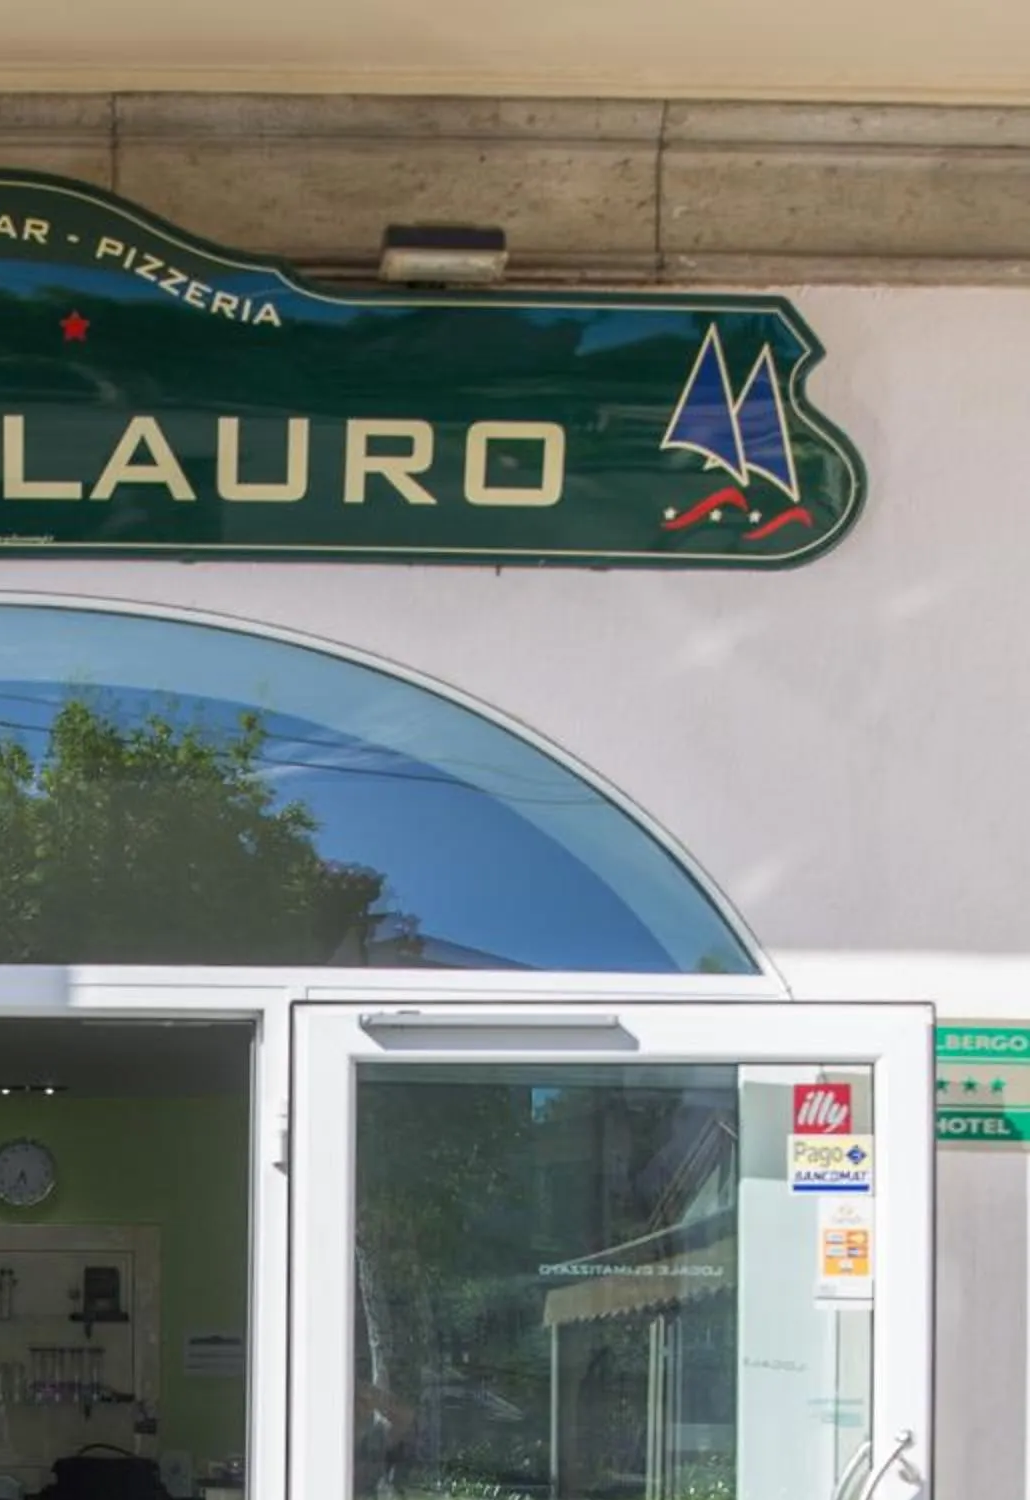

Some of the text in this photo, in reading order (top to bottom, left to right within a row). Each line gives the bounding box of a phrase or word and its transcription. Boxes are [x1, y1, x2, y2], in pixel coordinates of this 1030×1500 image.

[95, 235, 283, 327] PIZZERIA
[2, 413, 566, 507] LAURO
[936, 1034, 1028, 1051] BERGO
[797, 1090, 848, 1133] illy
[793, 1141, 844, 1168] Pago
